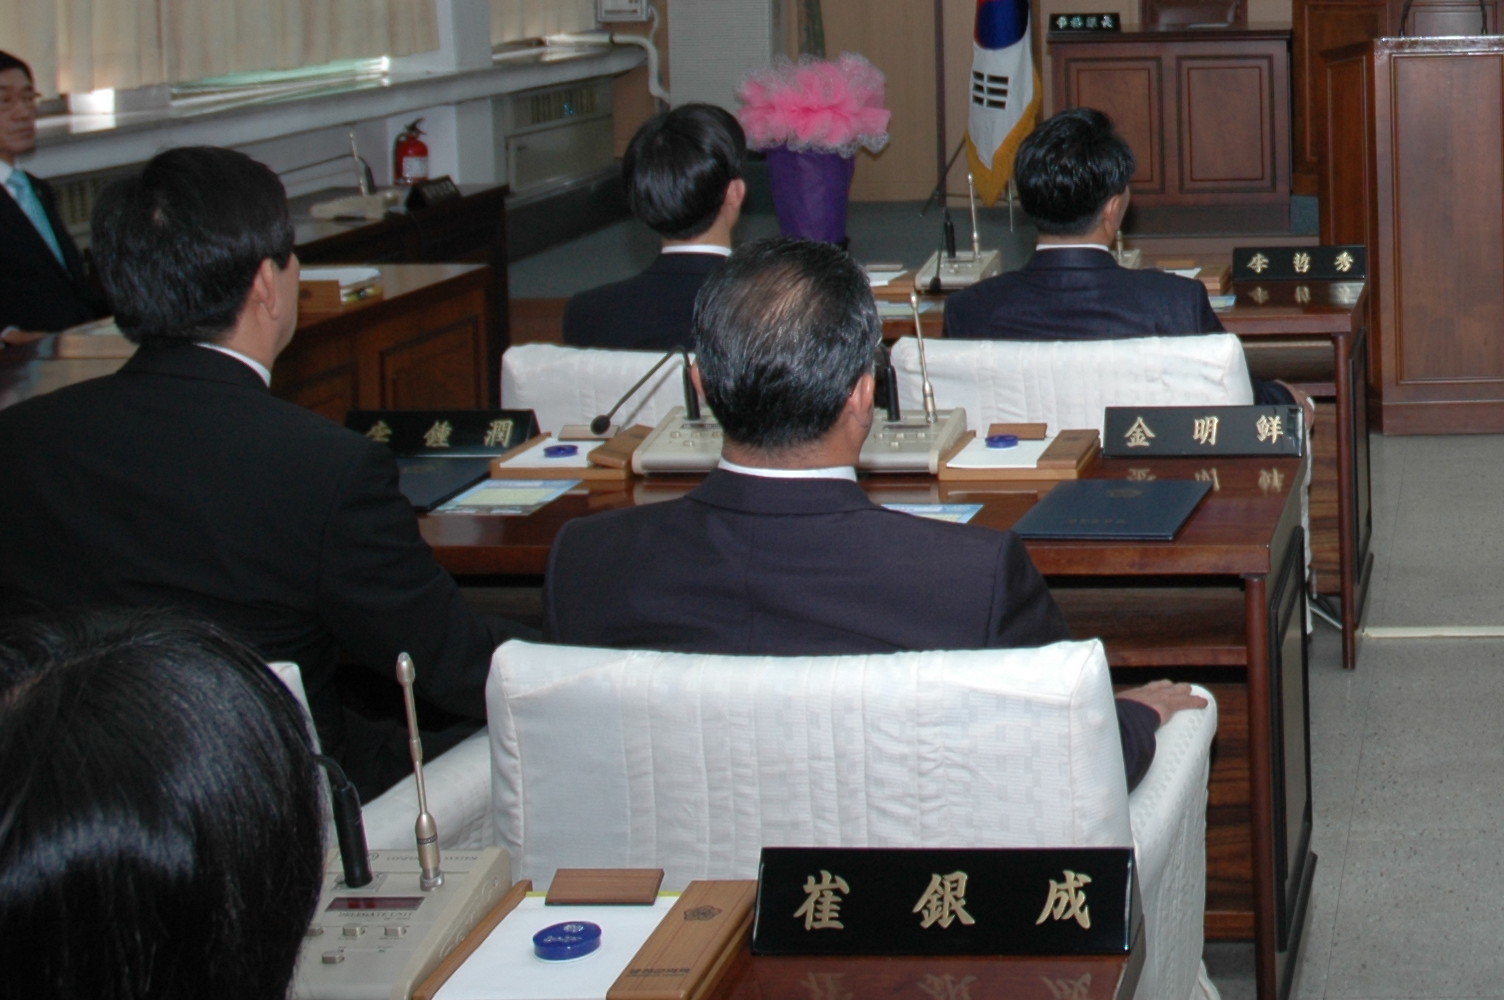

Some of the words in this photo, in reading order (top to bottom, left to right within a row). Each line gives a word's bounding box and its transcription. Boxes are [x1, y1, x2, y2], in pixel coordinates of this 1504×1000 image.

[1124, 414, 1284, 448] 金明鮮
[793, 869, 1093, 931] 崔銀成
